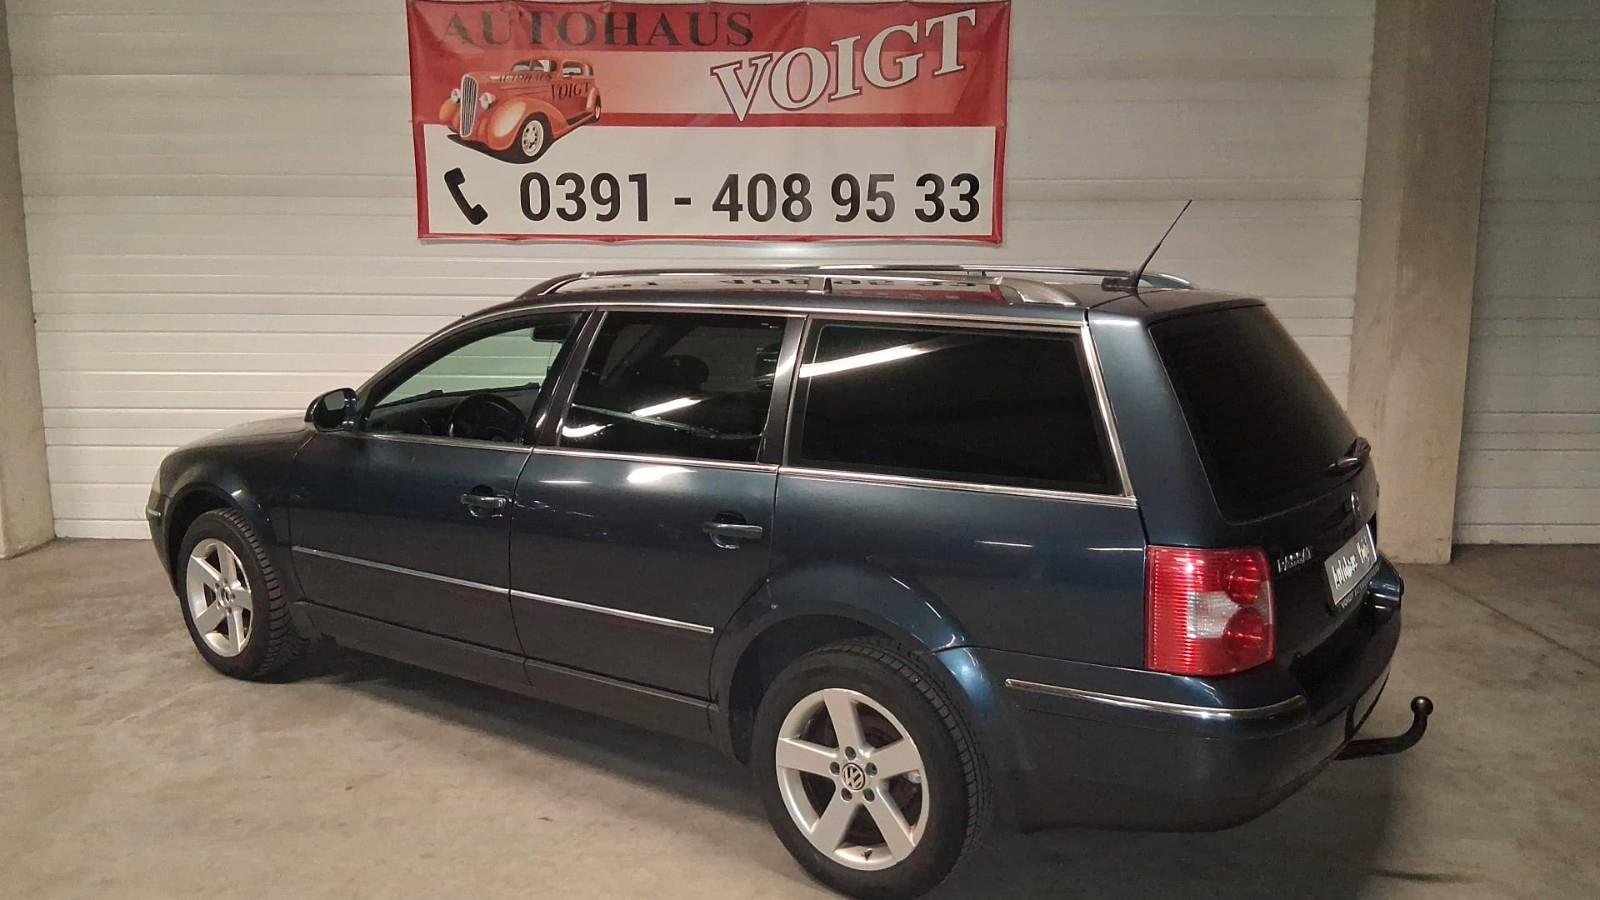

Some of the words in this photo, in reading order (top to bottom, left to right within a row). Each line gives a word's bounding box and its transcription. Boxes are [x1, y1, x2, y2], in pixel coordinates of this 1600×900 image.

[442, 10, 752, 47] AUTOHAUS
[710, 8, 977, 122] VOIGT
[520, 172, 648, 222] 0391
[711, 172, 812, 222] 408
[831, 172, 896, 223] 95
[914, 172, 980, 223] 33
